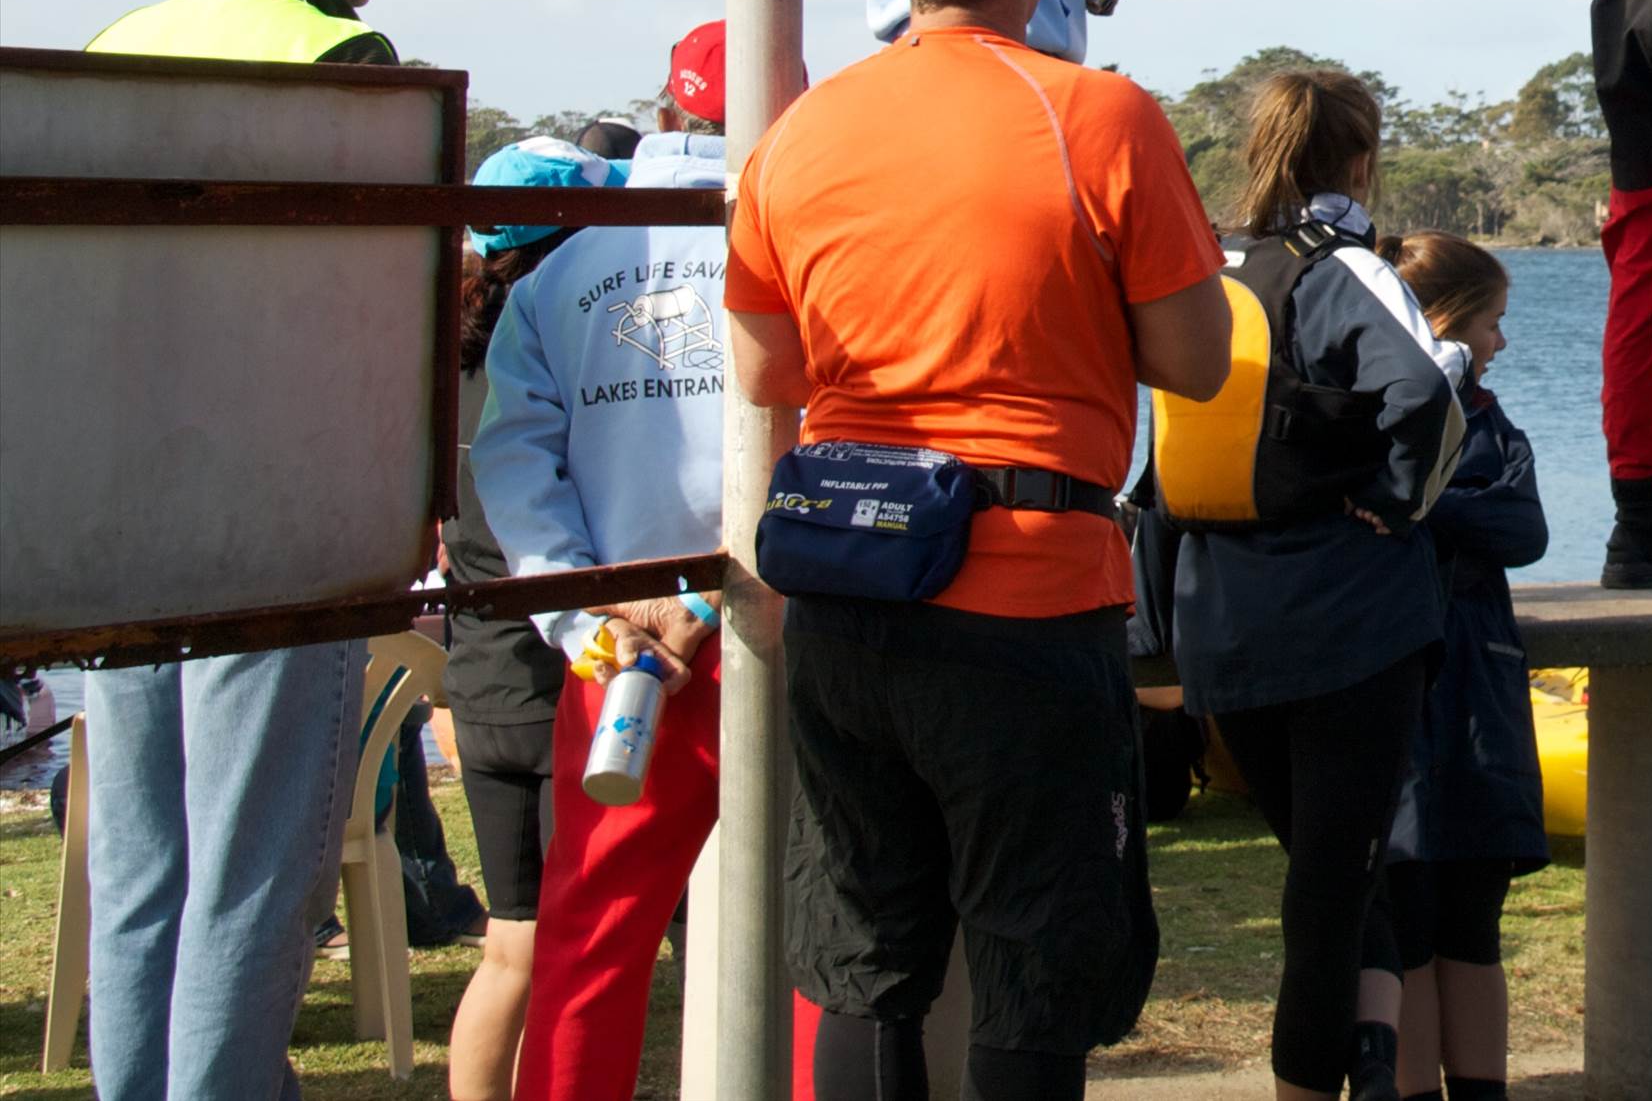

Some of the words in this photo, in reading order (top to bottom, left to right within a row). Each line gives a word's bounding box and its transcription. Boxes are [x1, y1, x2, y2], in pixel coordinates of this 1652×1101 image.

[578, 271, 627, 313] SURF
[635, 261, 675, 283] LIFE
[580, 380, 637, 407] LAKES
[820, 479, 870, 490] INFLATABLE
[880, 501, 914, 513] ADULT
